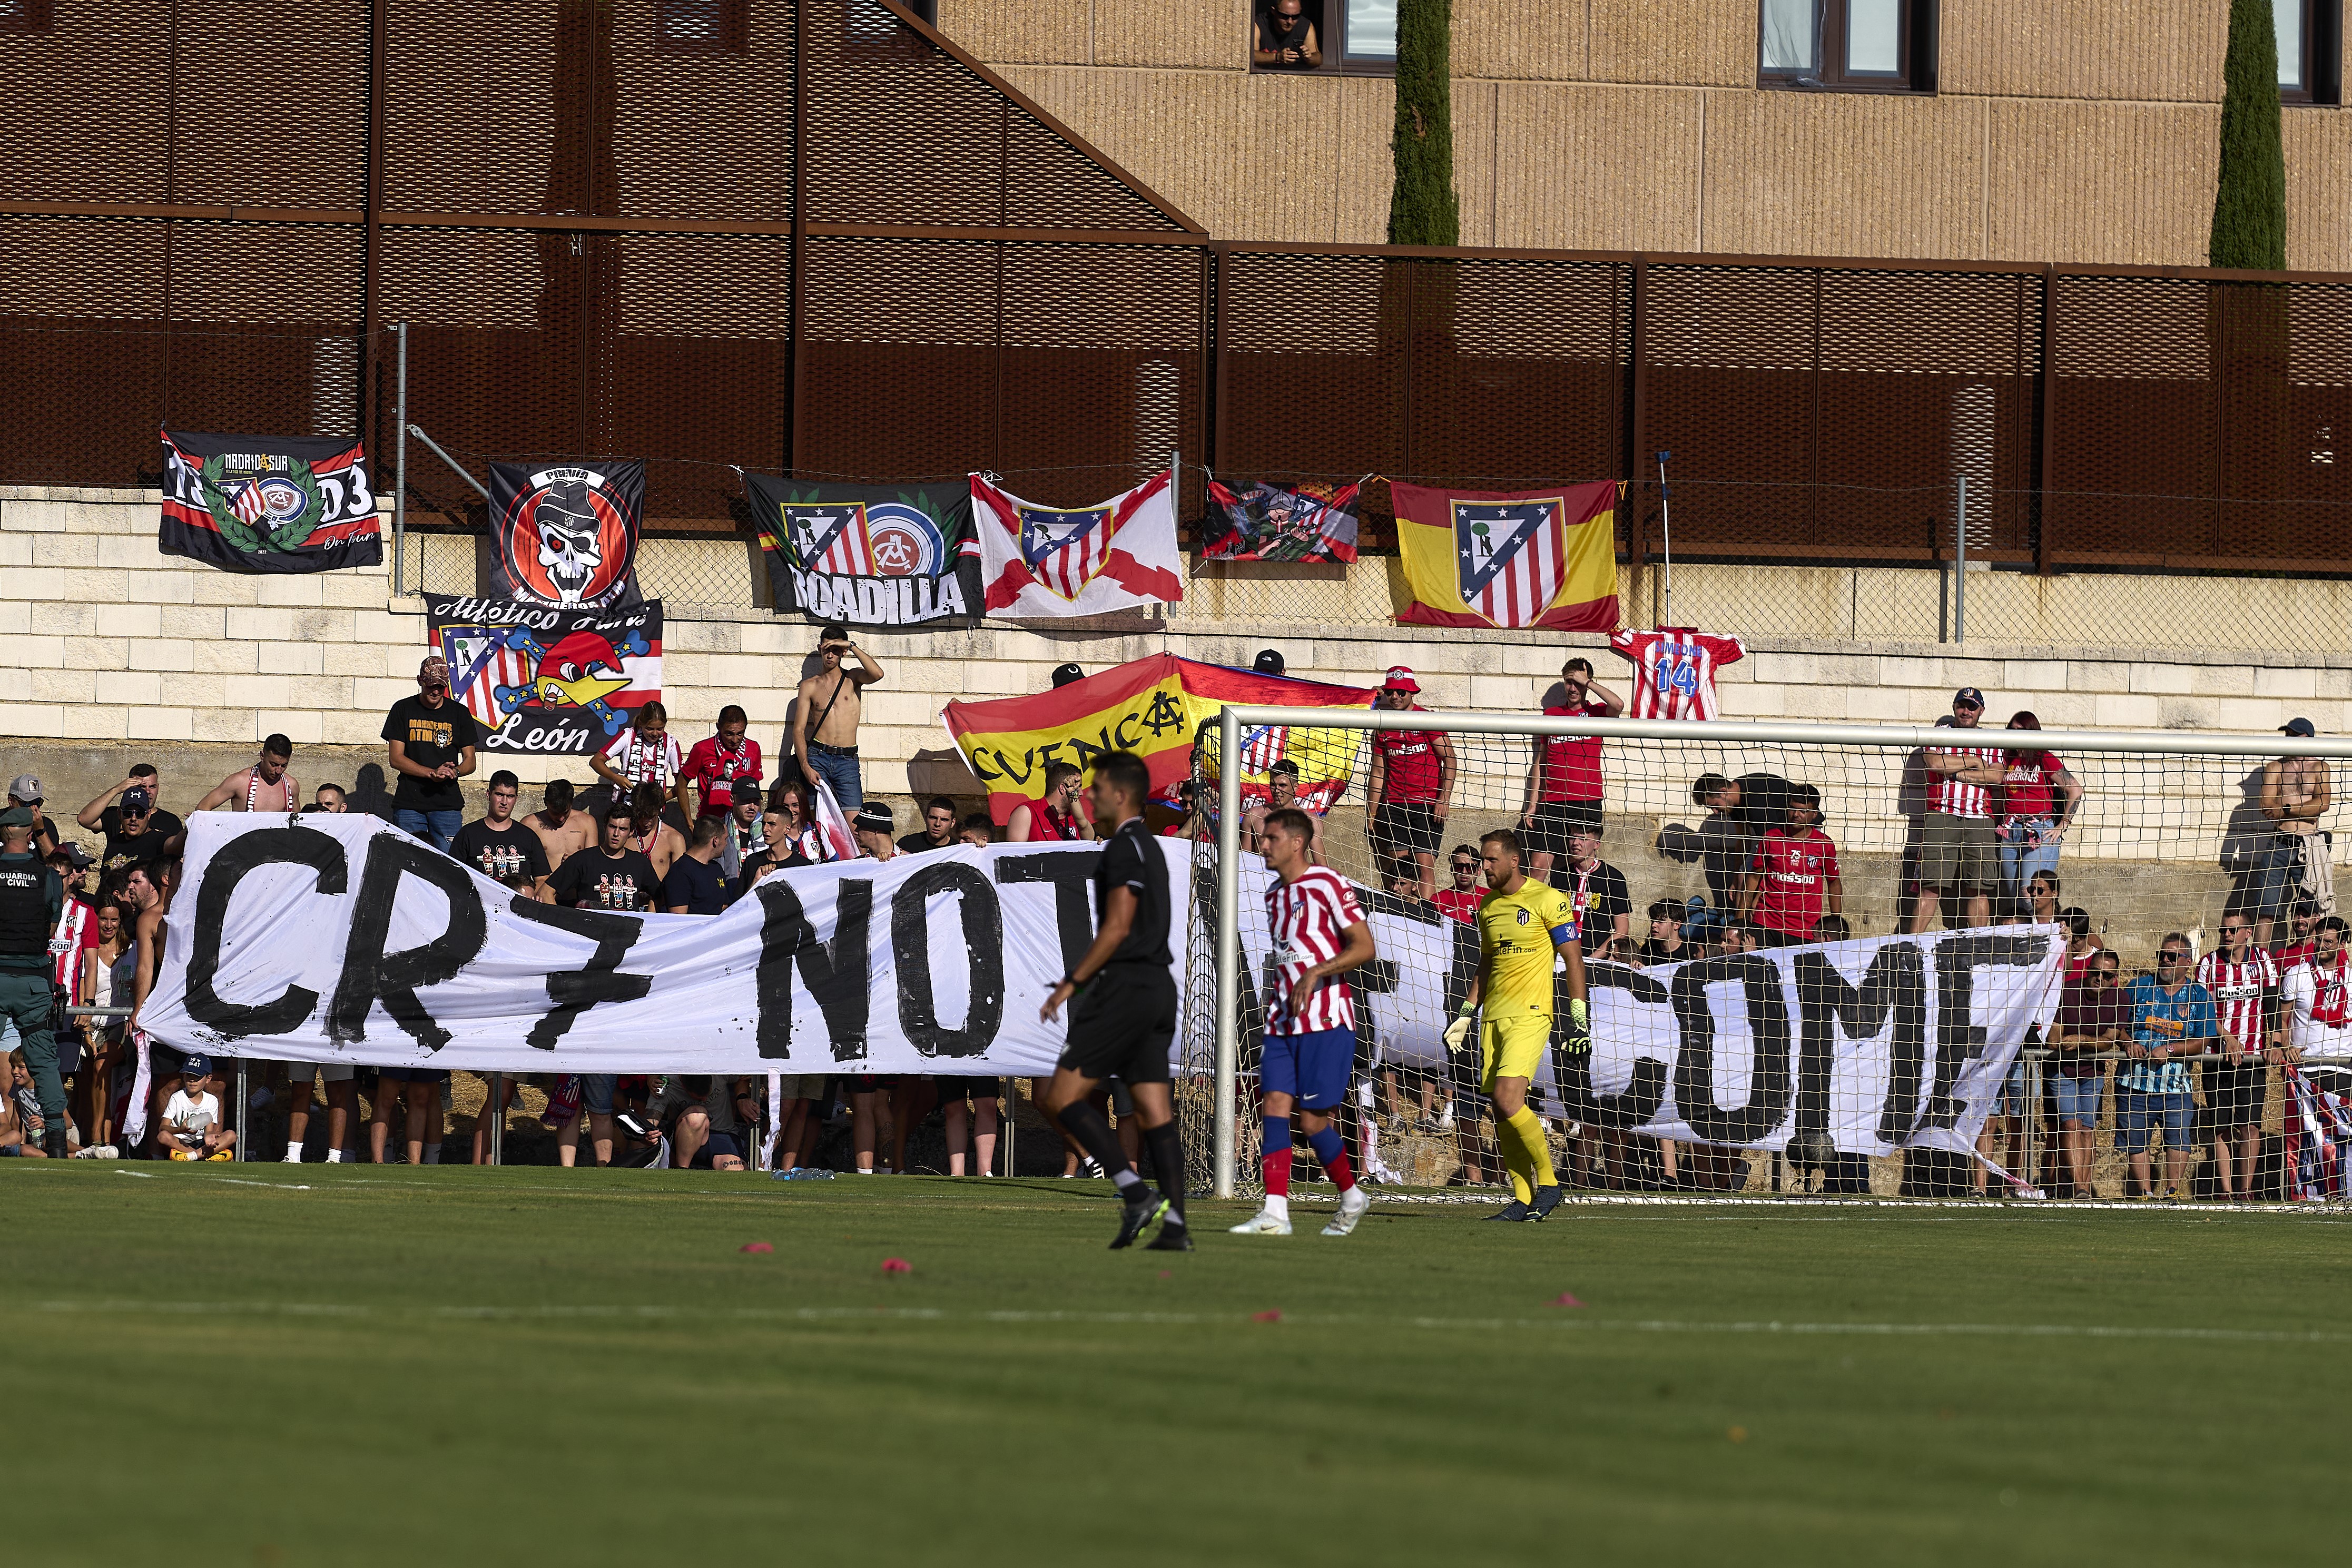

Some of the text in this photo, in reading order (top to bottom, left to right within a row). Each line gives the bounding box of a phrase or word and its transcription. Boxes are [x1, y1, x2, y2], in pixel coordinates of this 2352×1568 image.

[225, 453, 288, 471] MADRID SUR
[324, 528, 375, 550] On Tour
[599, 579, 626, 608] ATM
[434, 596, 560, 630] Atlético
[1655, 640, 1703, 658] SIMEONE
[1655, 657, 1698, 698] 14
[409, 719, 452, 731] MARINEROS
[409, 728, 433, 742] ATM
[486, 713, 590, 752] León
[711, 781, 733, 791] SIMEO
[1790, 850, 1801, 860] 75
[0, 872, 37, 881] GUARDIA
[7, 879, 29, 887] CIVIL
[183, 826, 653, 1052] CR7
[755, 850, 1104, 1063] NOT
[1493, 945, 1537, 956] aleFin.com
[1275, 952, 1313, 964] aleFin.com
[2218, 987, 2258, 997] Plus500
